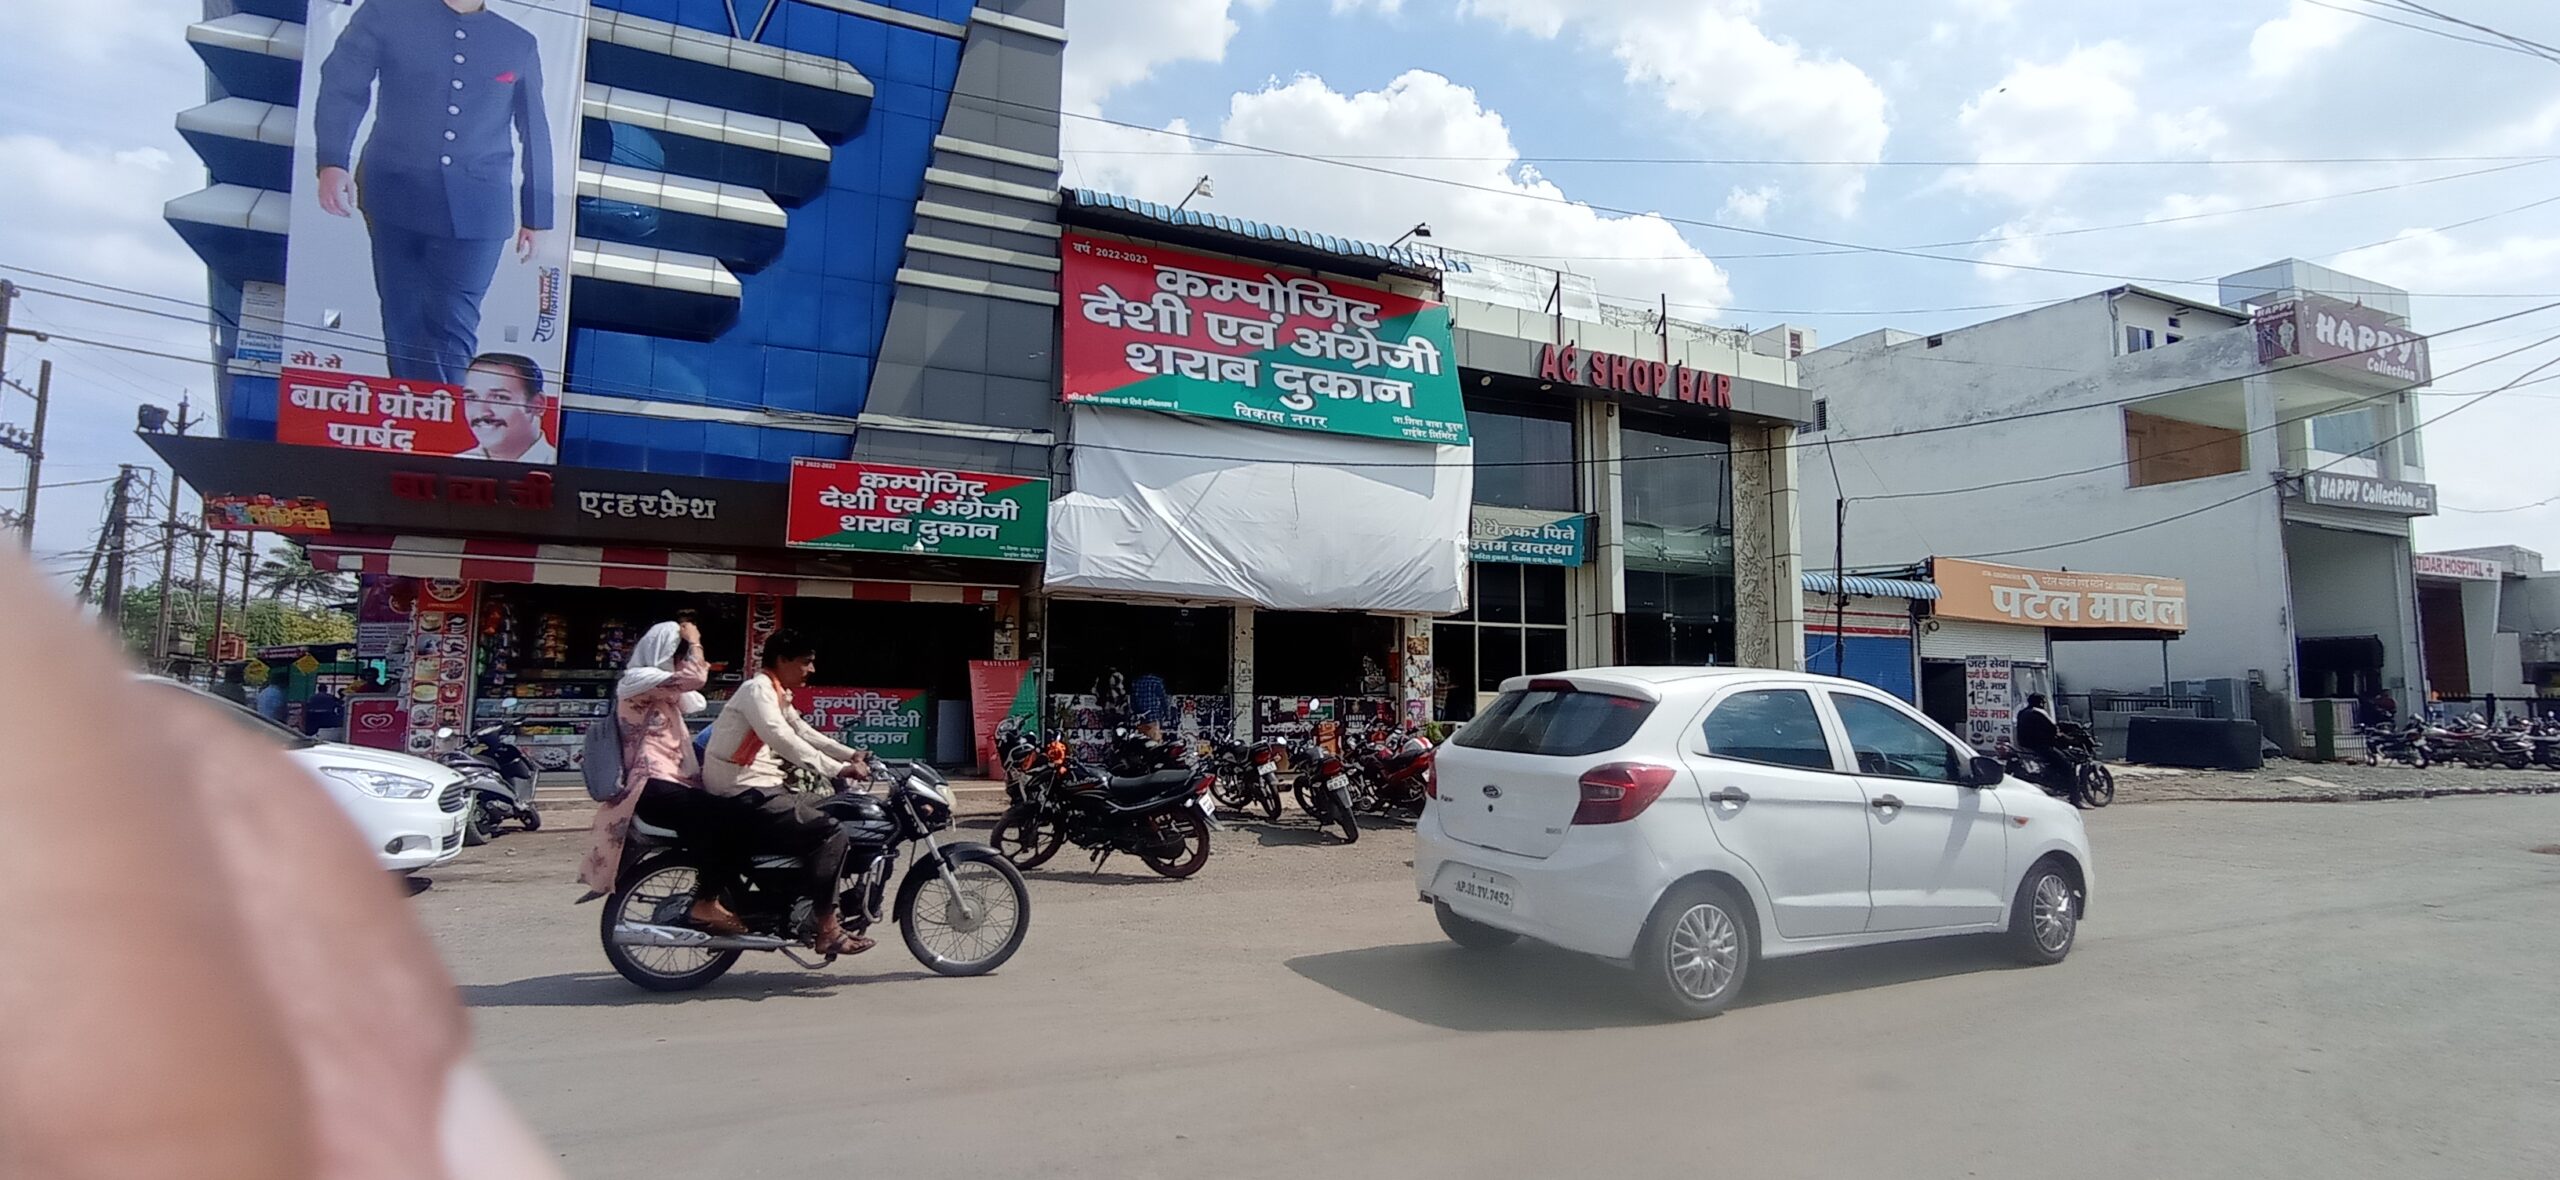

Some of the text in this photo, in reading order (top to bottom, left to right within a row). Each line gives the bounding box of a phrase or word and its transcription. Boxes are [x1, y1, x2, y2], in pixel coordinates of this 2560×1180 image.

[1072, 240, 1149, 265] वर्ष 2022-2023
[1153, 263, 1382, 330] कम्पोजिट
[2256, 301, 2294, 317] HAPPY
[1080, 284, 1443, 376] देशी एवं अंग्रेजी
[2315, 312, 2412, 364] HAPPY
[1125, 342, 1413, 411] शराब दुकान
[1539, 342, 1732, 409] AC SHOP BAR
[2366, 357, 2416, 382] Collection
[289, 381, 456, 423] बाली घोसी
[1233, 402, 1328, 429] विकास नगर
[327, 420, 416, 451] पार्षद
[858, 471, 988, 497] कम्पोजिट
[2320, 476, 2360, 502] HAPPY
[2361, 482, 2414, 508] Collection
[819, 485, 1020, 521] देशी एवं अंग्रेजी
[840, 515, 1000, 544] शराब दुकान
[1511, 541, 1574, 556] व्यवस्था
[2414, 555, 2484, 577] TIDAR HOSPITAL
[1990, 574, 2185, 625] पटेल मार्बल
[1967, 657, 2009, 668] जल सेवा
[813, 691, 902, 711] कम्पोजिट
[1968, 706, 2010, 719] केक मात्र
[865, 710, 922, 728] विदेशी
[1969, 720, 1998, 733] 100/-
[852, 730, 909, 751] दुकान
